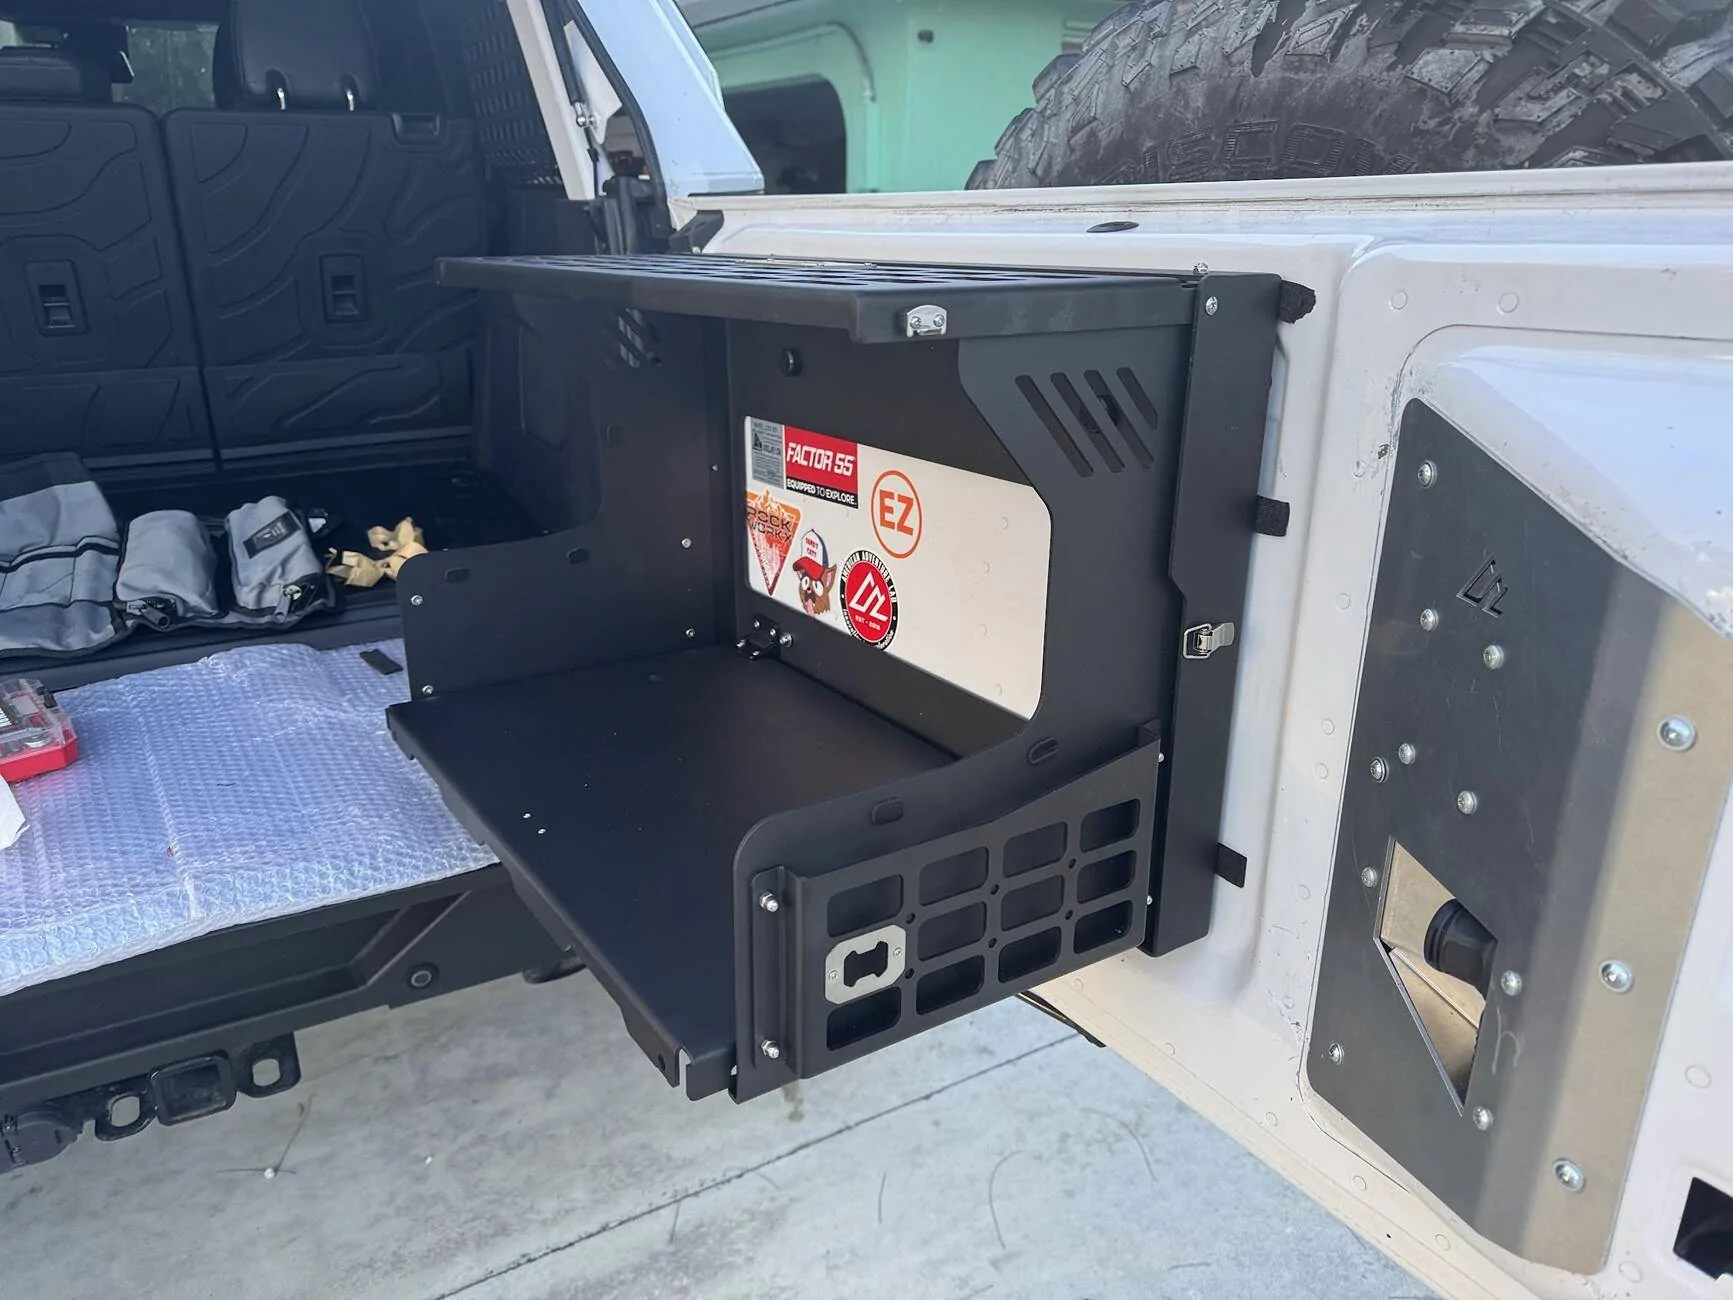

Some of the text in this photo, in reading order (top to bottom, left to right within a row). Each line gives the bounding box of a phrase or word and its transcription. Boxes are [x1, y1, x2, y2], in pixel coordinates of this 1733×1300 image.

[786, 441, 833, 472] FACTOR
[834, 453, 855, 477] 55
[787, 478, 855, 505] EQUIPPED TO EXPLORE
[879, 489, 914, 536] EZ
